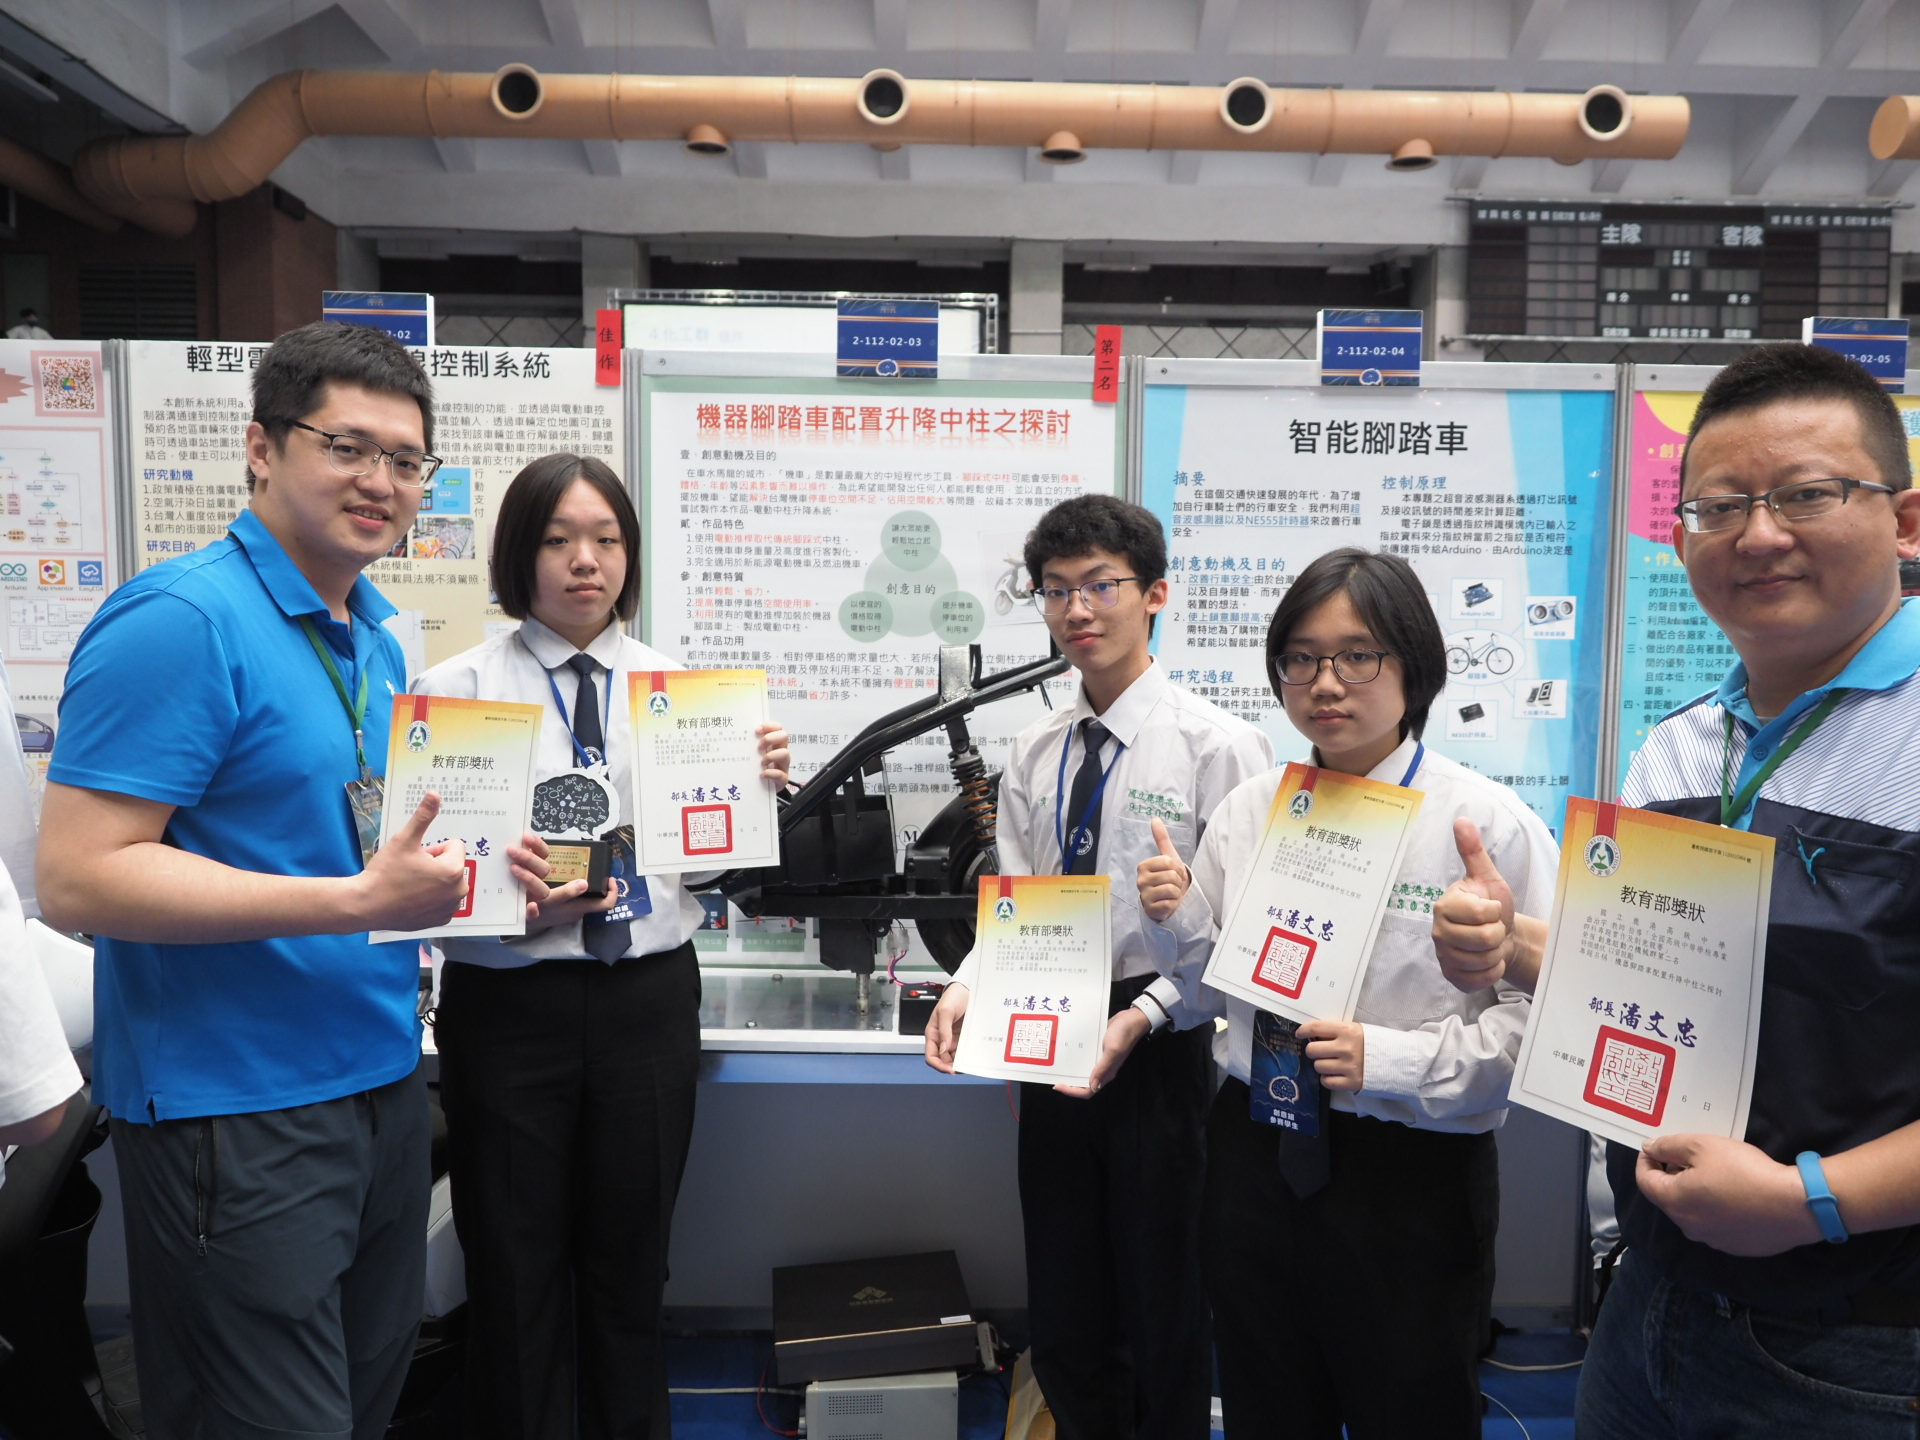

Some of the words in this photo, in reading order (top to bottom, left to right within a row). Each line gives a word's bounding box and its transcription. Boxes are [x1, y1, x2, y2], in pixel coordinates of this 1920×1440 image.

[1601, 223, 1642, 244] 主隊
[1722, 225, 1764, 246] 客隊
[852, 336, 922, 347] 2-112-02-03
[598, 327, 615, 371] 佳作
[1337, 346, 1405, 356] 2-112-02-04
[411, 349, 550, 378] 控制系統
[1097, 339, 1115, 391] 第二名
[696, 403, 1071, 434] 機器腳踏車配置升降中柱之探討
[1289, 418, 1468, 456] 智能腳踏車
[680, 449, 777, 461] 壹、創意動機及目的
[143, 468, 194, 481] 研究動機
[1173, 471, 1206, 487] 摘要
[1381, 475, 1447, 490] 控制原理
[473, 468, 485, 518] 行動支付
[680, 518, 745, 530] 貳、作品特色
[1172, 527, 1200, 538] 安全。
[146, 540, 196, 553] 研究目的
[903, 549, 919, 557] 中柱
[1171, 556, 1285, 571] 創意動機及目的
[886, 583, 937, 595] 創意目的
[850, 600, 882, 609] 以便宜的
[942, 601, 973, 610] 提升機車
[1187, 599, 1248, 610] 裝置的想法。
[850, 612, 882, 621] 價格取得
[942, 614, 973, 622] 停車位的
[850, 624, 882, 633] 電動中柱
[946, 625, 969, 634] 利用率
[680, 635, 744, 647] 肆、作品功用
[1168, 669, 1235, 684] 研究過程
[676, 716, 734, 730] 教育部獎狀
[432, 754, 495, 770] 教育部獎狀
[691, 784, 742, 803] 潘文忠
[903, 830, 918, 839] M
[1304, 824, 1362, 852] 教育部獎狀
[1620, 884, 1706, 924] 教育部獎狀
[1019, 924, 1074, 938] 教育部獎狀
[1284, 909, 1334, 942] 潘文忠
[1022, 995, 1072, 1013] 潘文忠
[1588, 996, 1615, 1018] 部長
[1619, 1002, 1698, 1048] 潘文忠
[1552, 1049, 1585, 1068] 中華民國
[1681, 1094, 1687, 1103] 6
[1703, 1101, 1711, 1111] 日
